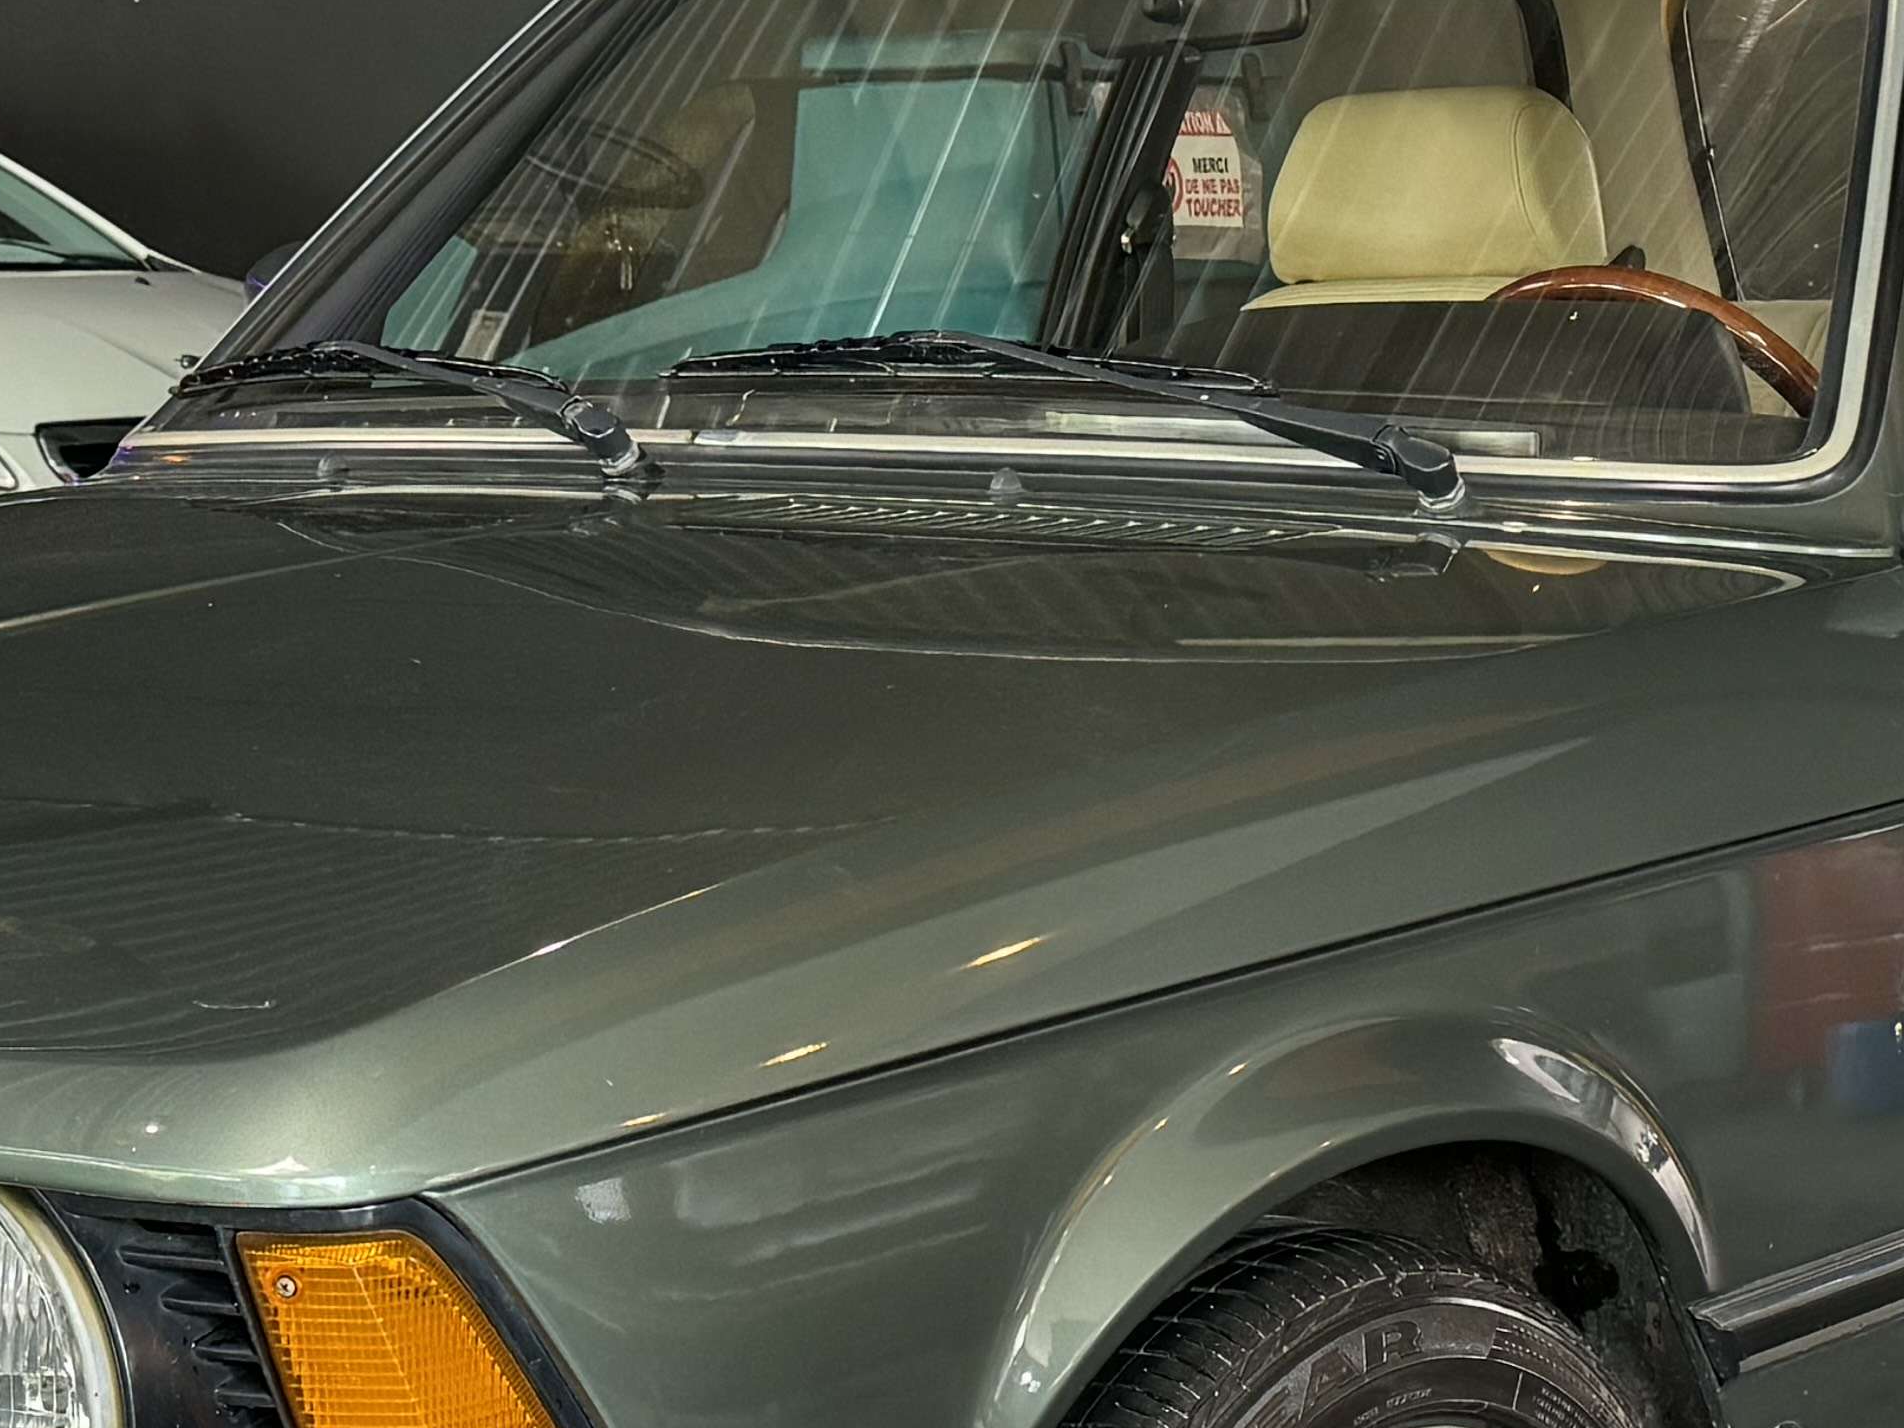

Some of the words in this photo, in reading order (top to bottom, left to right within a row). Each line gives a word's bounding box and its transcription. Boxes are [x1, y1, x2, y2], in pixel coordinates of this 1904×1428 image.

[1192, 157, 1230, 174] MERCI
[1185, 179, 1200, 194] DE
[1220, 178, 1241, 194] PAS
[1185, 198, 1242, 218] TOUCHER
